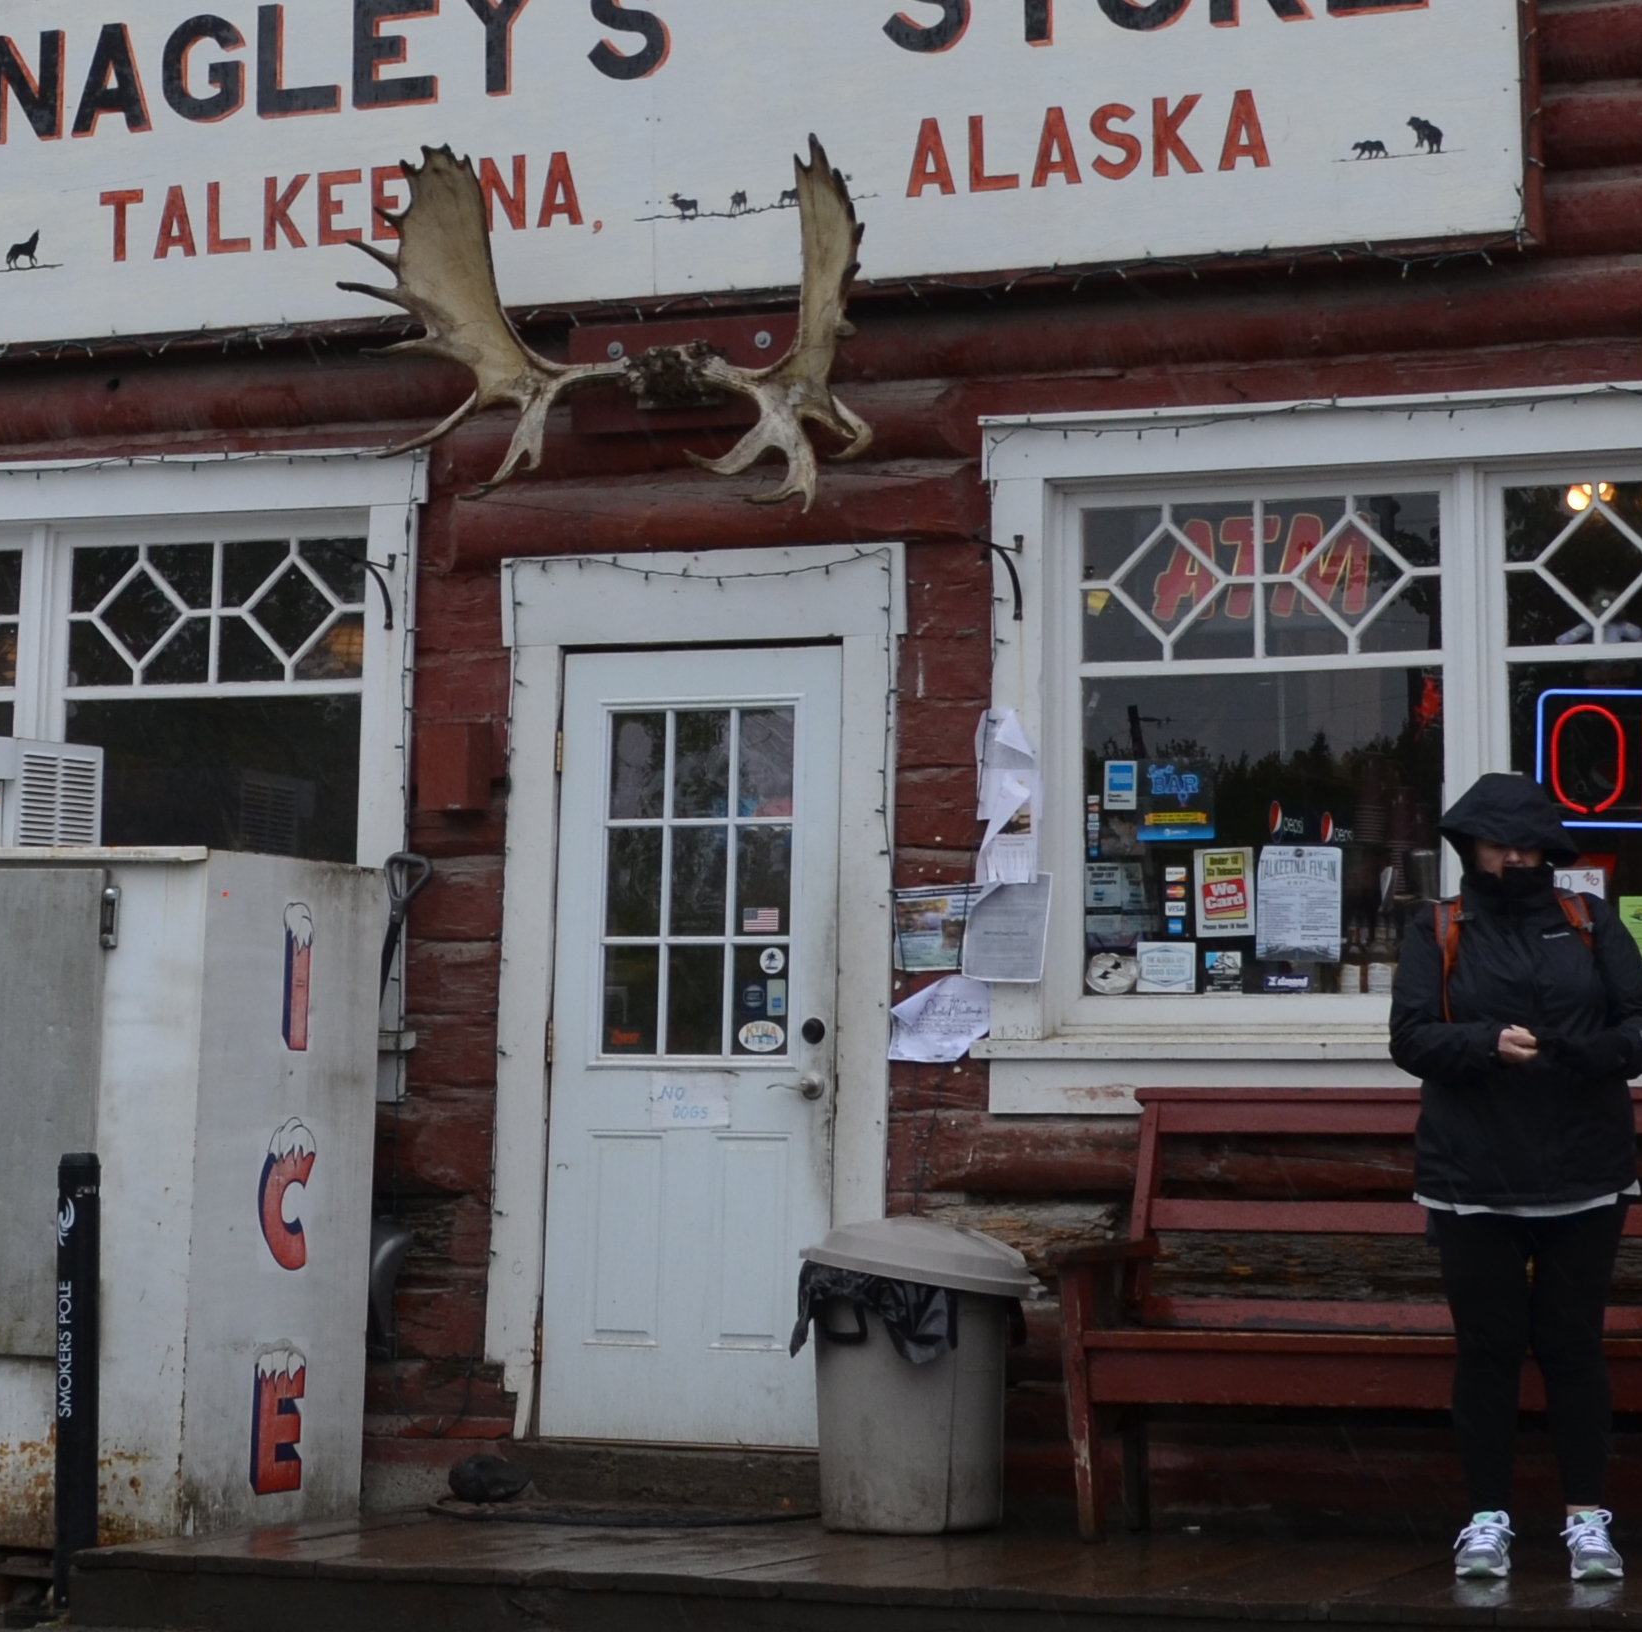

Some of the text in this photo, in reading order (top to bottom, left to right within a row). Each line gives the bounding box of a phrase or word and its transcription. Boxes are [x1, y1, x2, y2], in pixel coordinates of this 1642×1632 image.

[99, 89, 1271, 263] TALKEENA, ALASKA
[1152, 513, 1371, 621] ATM
[1151, 774, 1199, 794] BAR
[1283, 816, 1305, 836] pepsi
[1260, 859, 1337, 883] TALKEETNA FLY-IN
[1209, 882, 1238, 897] We
[1205, 892, 1245, 910] Card
[660, 1086, 685, 1100] NO
[672, 1105, 709, 1119] DOGS
[59, 1281, 72, 1324] POLE
